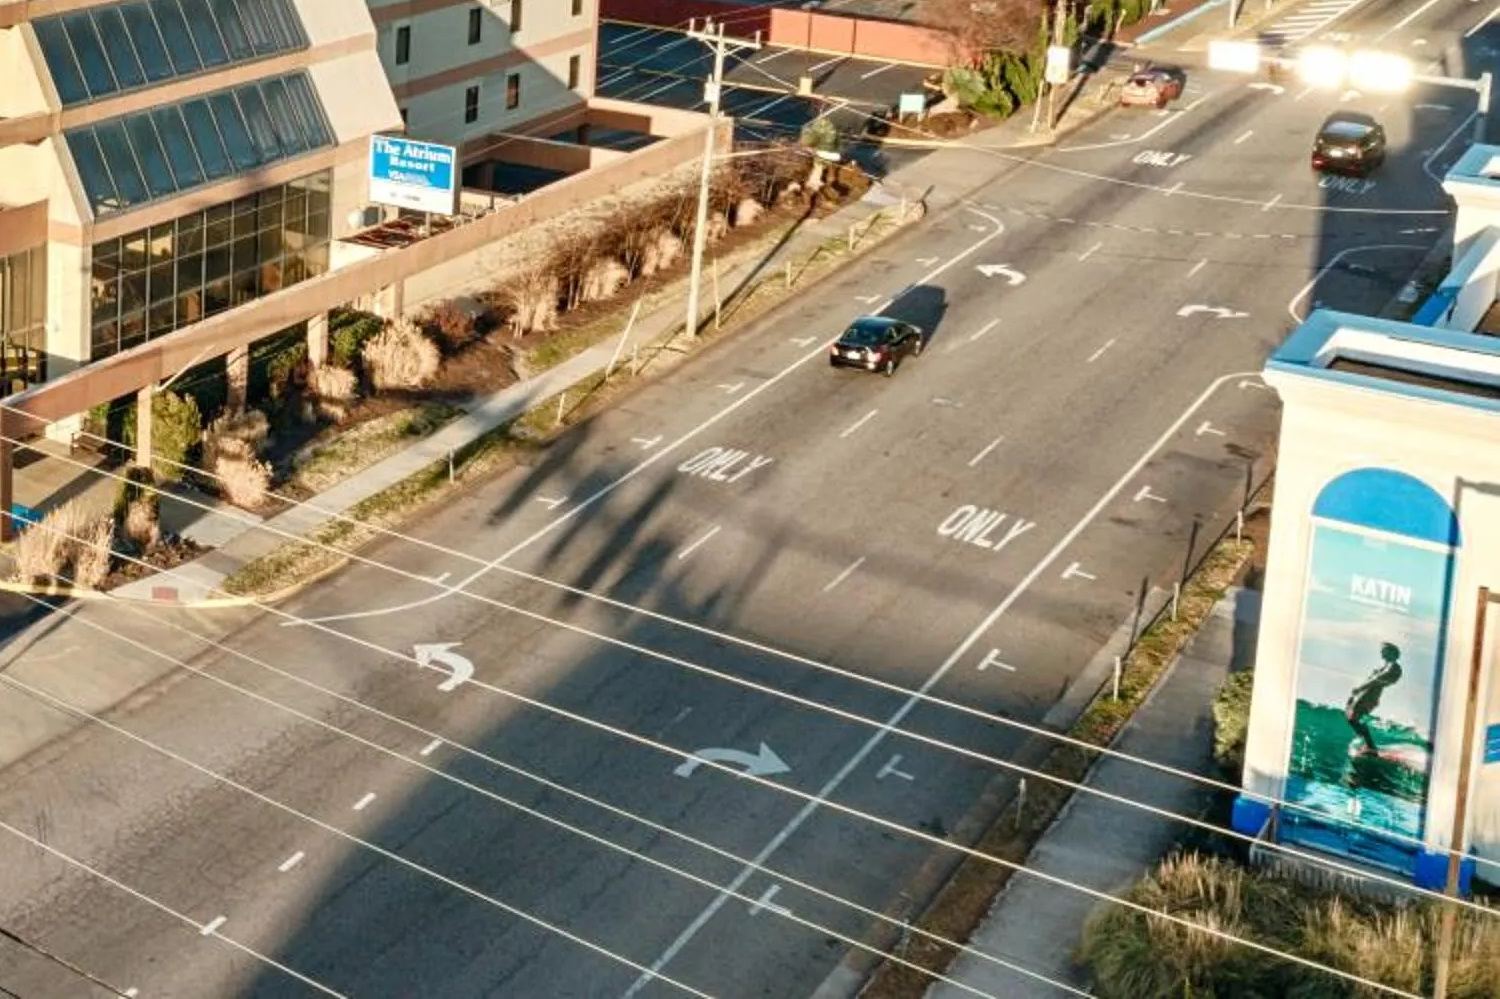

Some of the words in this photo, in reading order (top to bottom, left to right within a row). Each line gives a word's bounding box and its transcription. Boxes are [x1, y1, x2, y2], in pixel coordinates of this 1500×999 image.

[373, 139, 401, 156] The
[404, 144, 451, 164] Atrium
[1132, 150, 1193, 167] ONLY
[389, 156, 435, 173] Resort
[1317, 176, 1377, 194] ONLY
[677, 446, 773, 483] ONLY
[937, 504, 1037, 552] ONLY
[1351, 573, 1411, 605] KATIN
